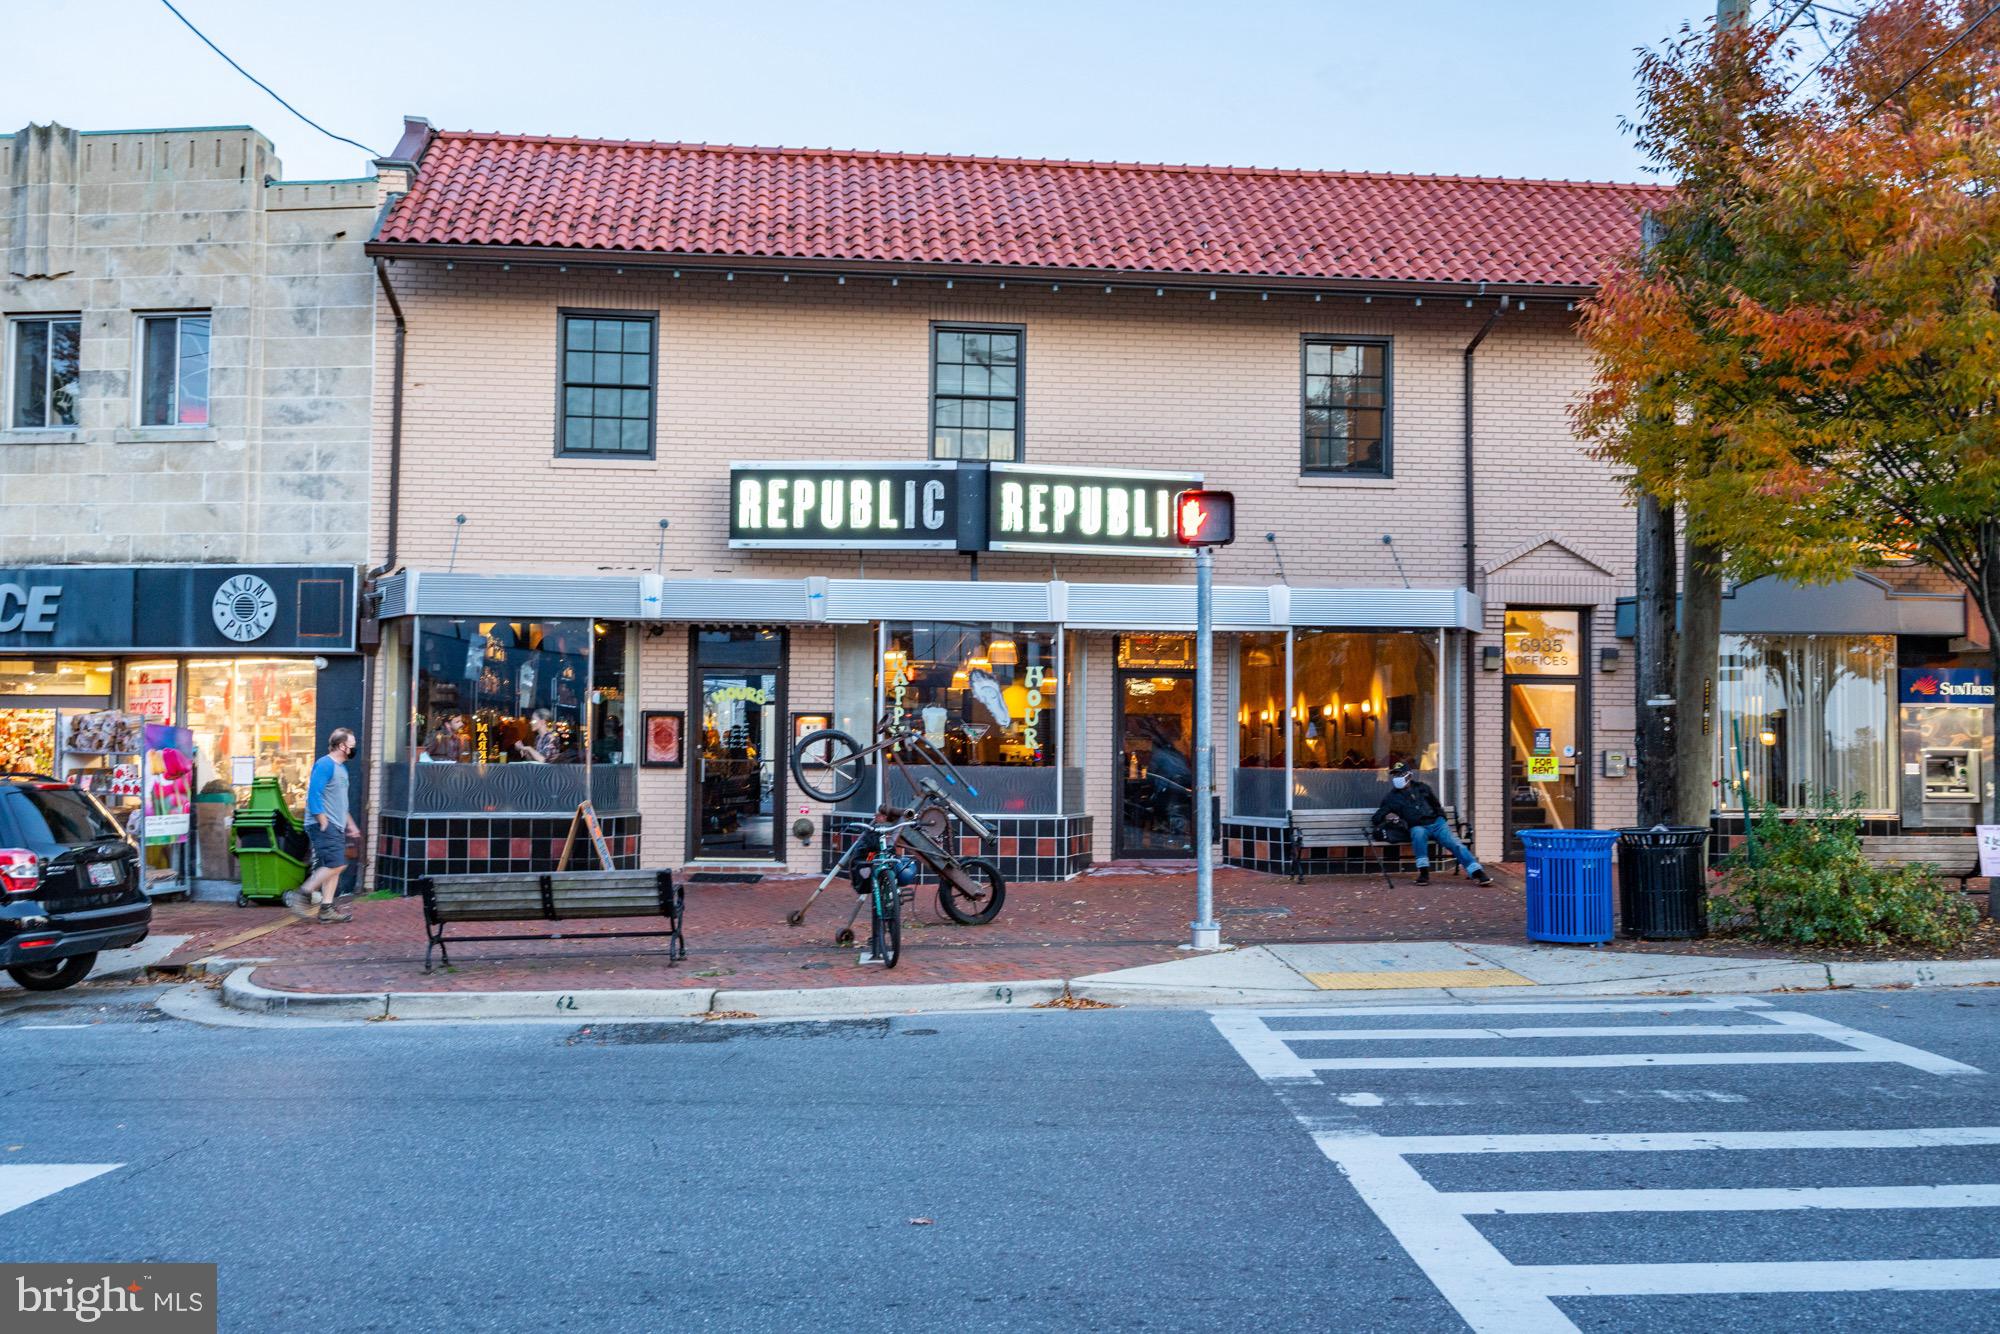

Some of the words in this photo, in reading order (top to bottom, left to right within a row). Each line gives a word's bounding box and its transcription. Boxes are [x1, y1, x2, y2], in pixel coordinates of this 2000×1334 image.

[738, 479, 945, 530] REPUBLIC
[1001, 482, 1188, 538] REPUBLI
[215, 576, 274, 608] TAKOMA
[0, 583, 63, 632] CE
[223, 618, 267, 639] PARK
[1520, 638, 1563, 653] 6935
[1514, 655, 1568, 666] OFFICES
[711, 687, 767, 705] HOURS
[1024, 666, 1044, 749] HOUR
[1532, 766, 1555, 775] RENT
[1535, 758, 1552, 766] FOR
